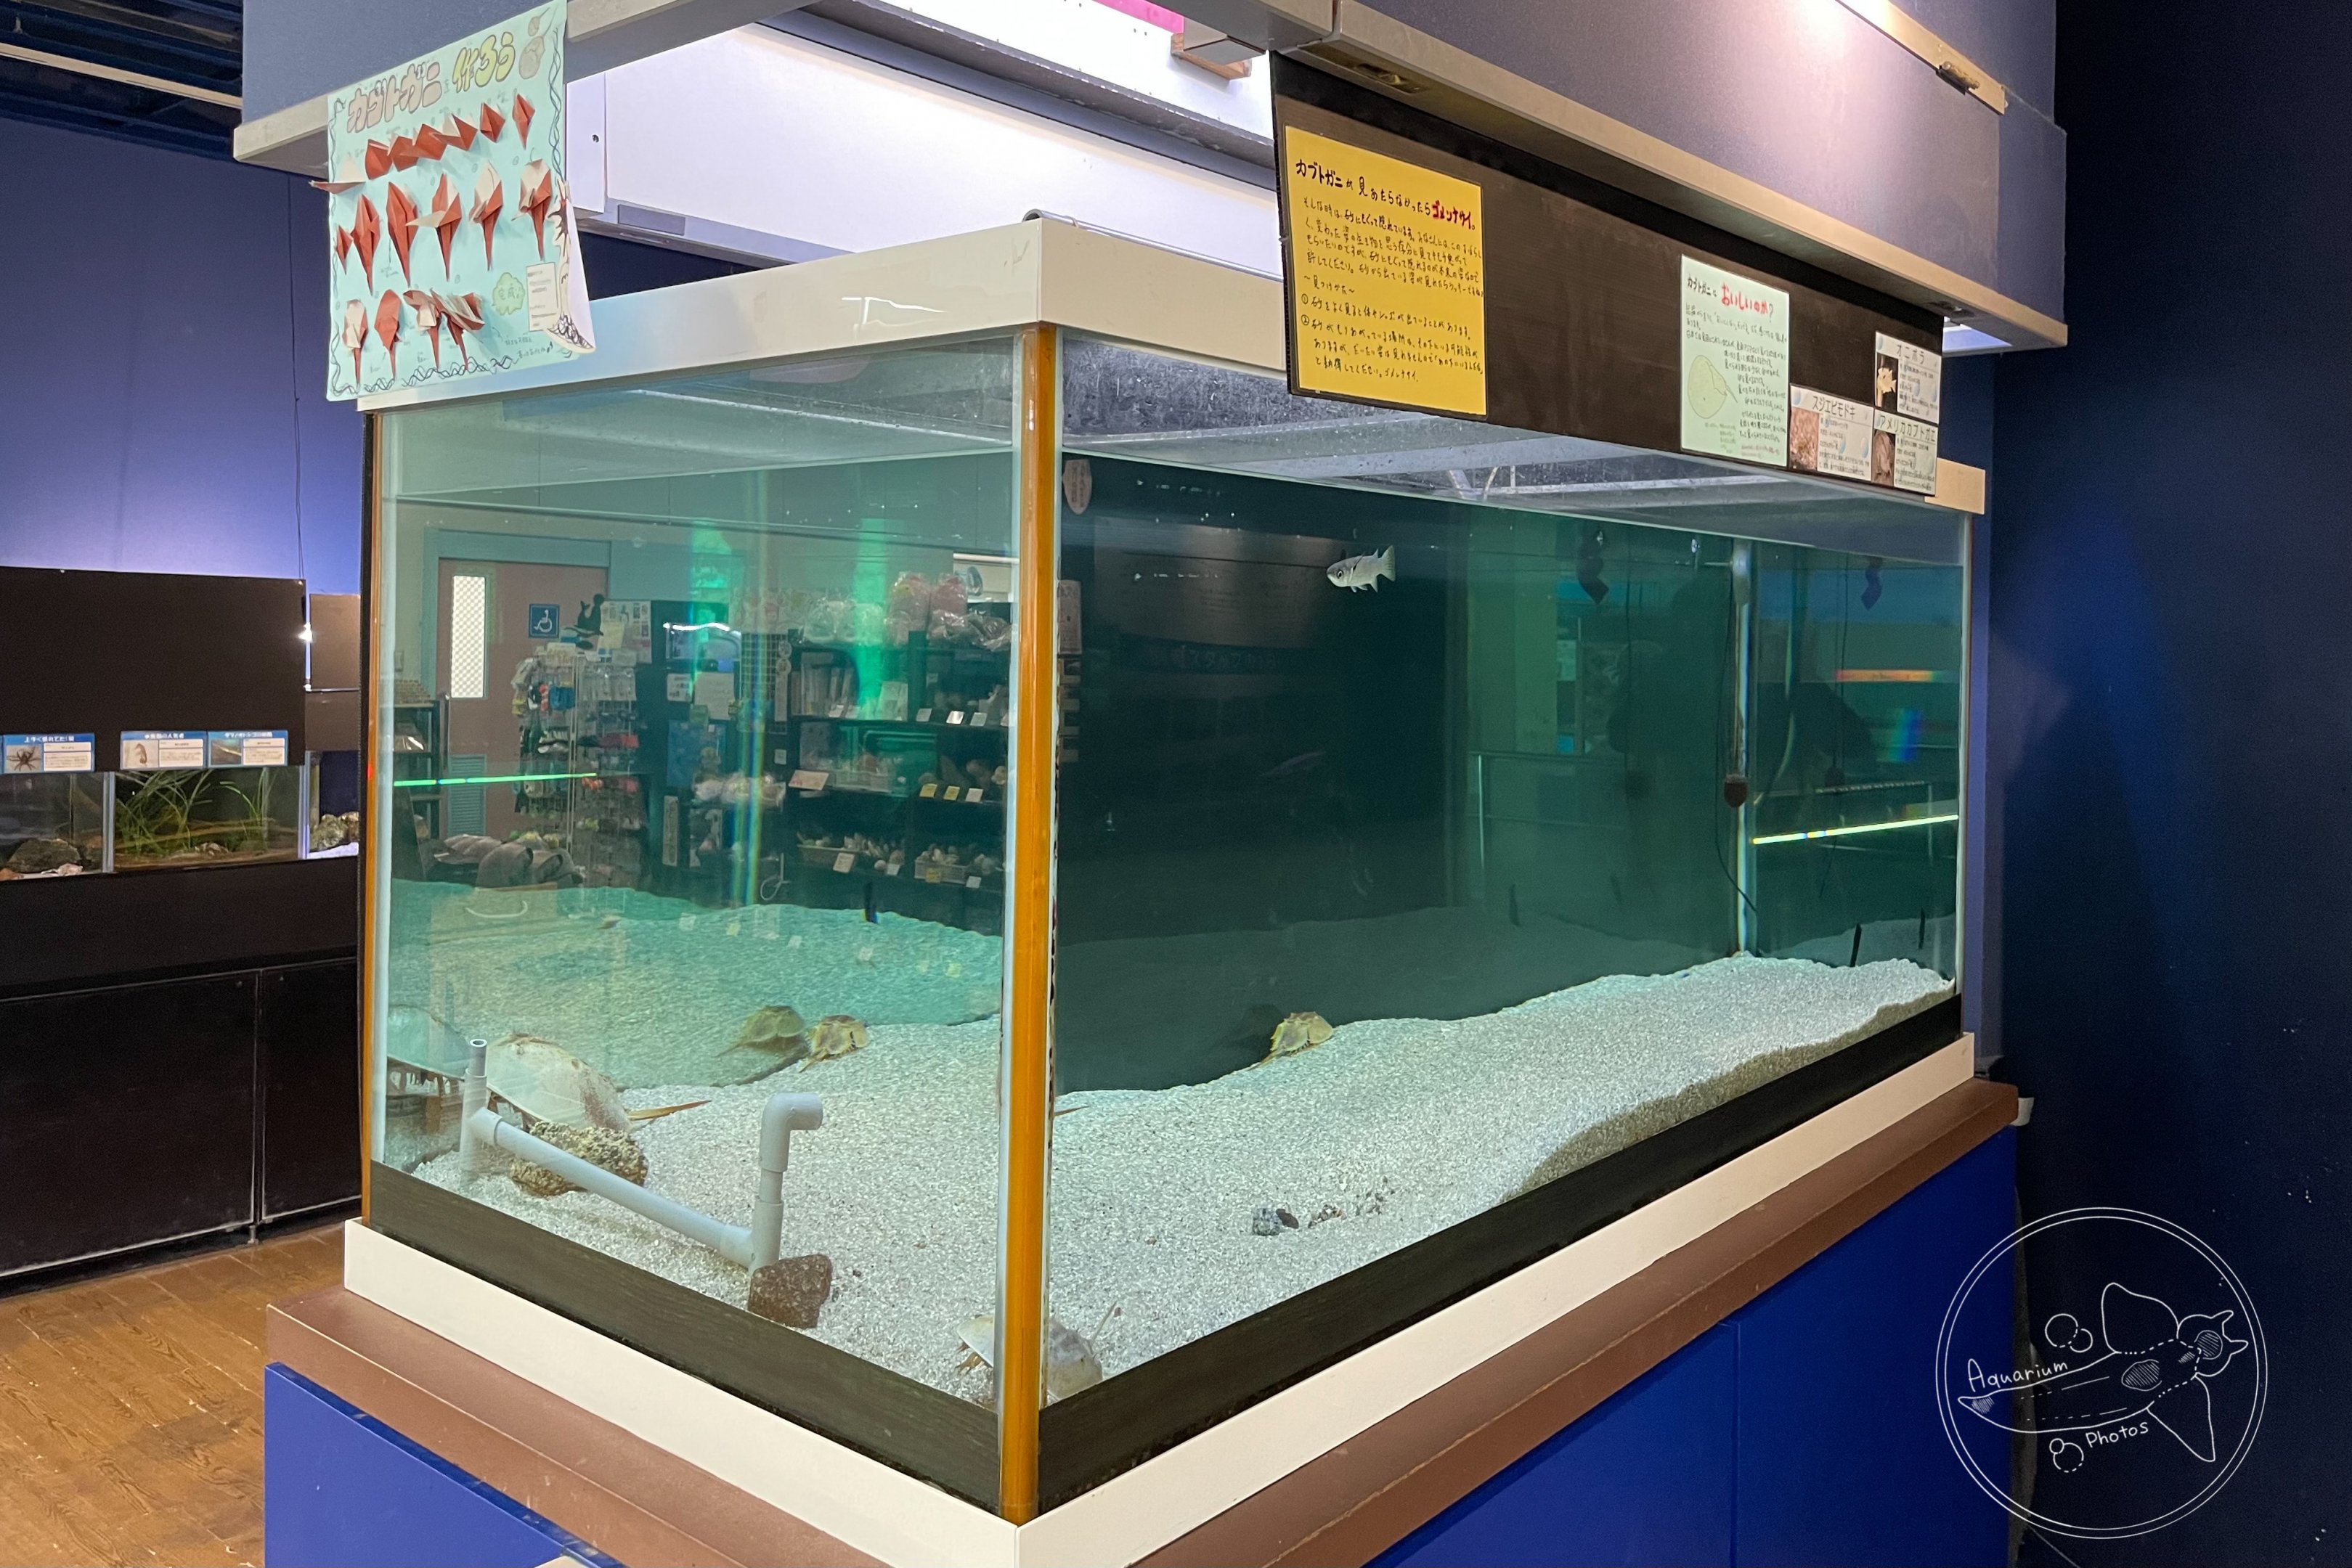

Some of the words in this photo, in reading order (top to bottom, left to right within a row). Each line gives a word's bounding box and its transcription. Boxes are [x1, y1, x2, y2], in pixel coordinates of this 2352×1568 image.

[346, 61, 442, 133] カブトガニ
[452, 31, 516, 94] 作ろう
